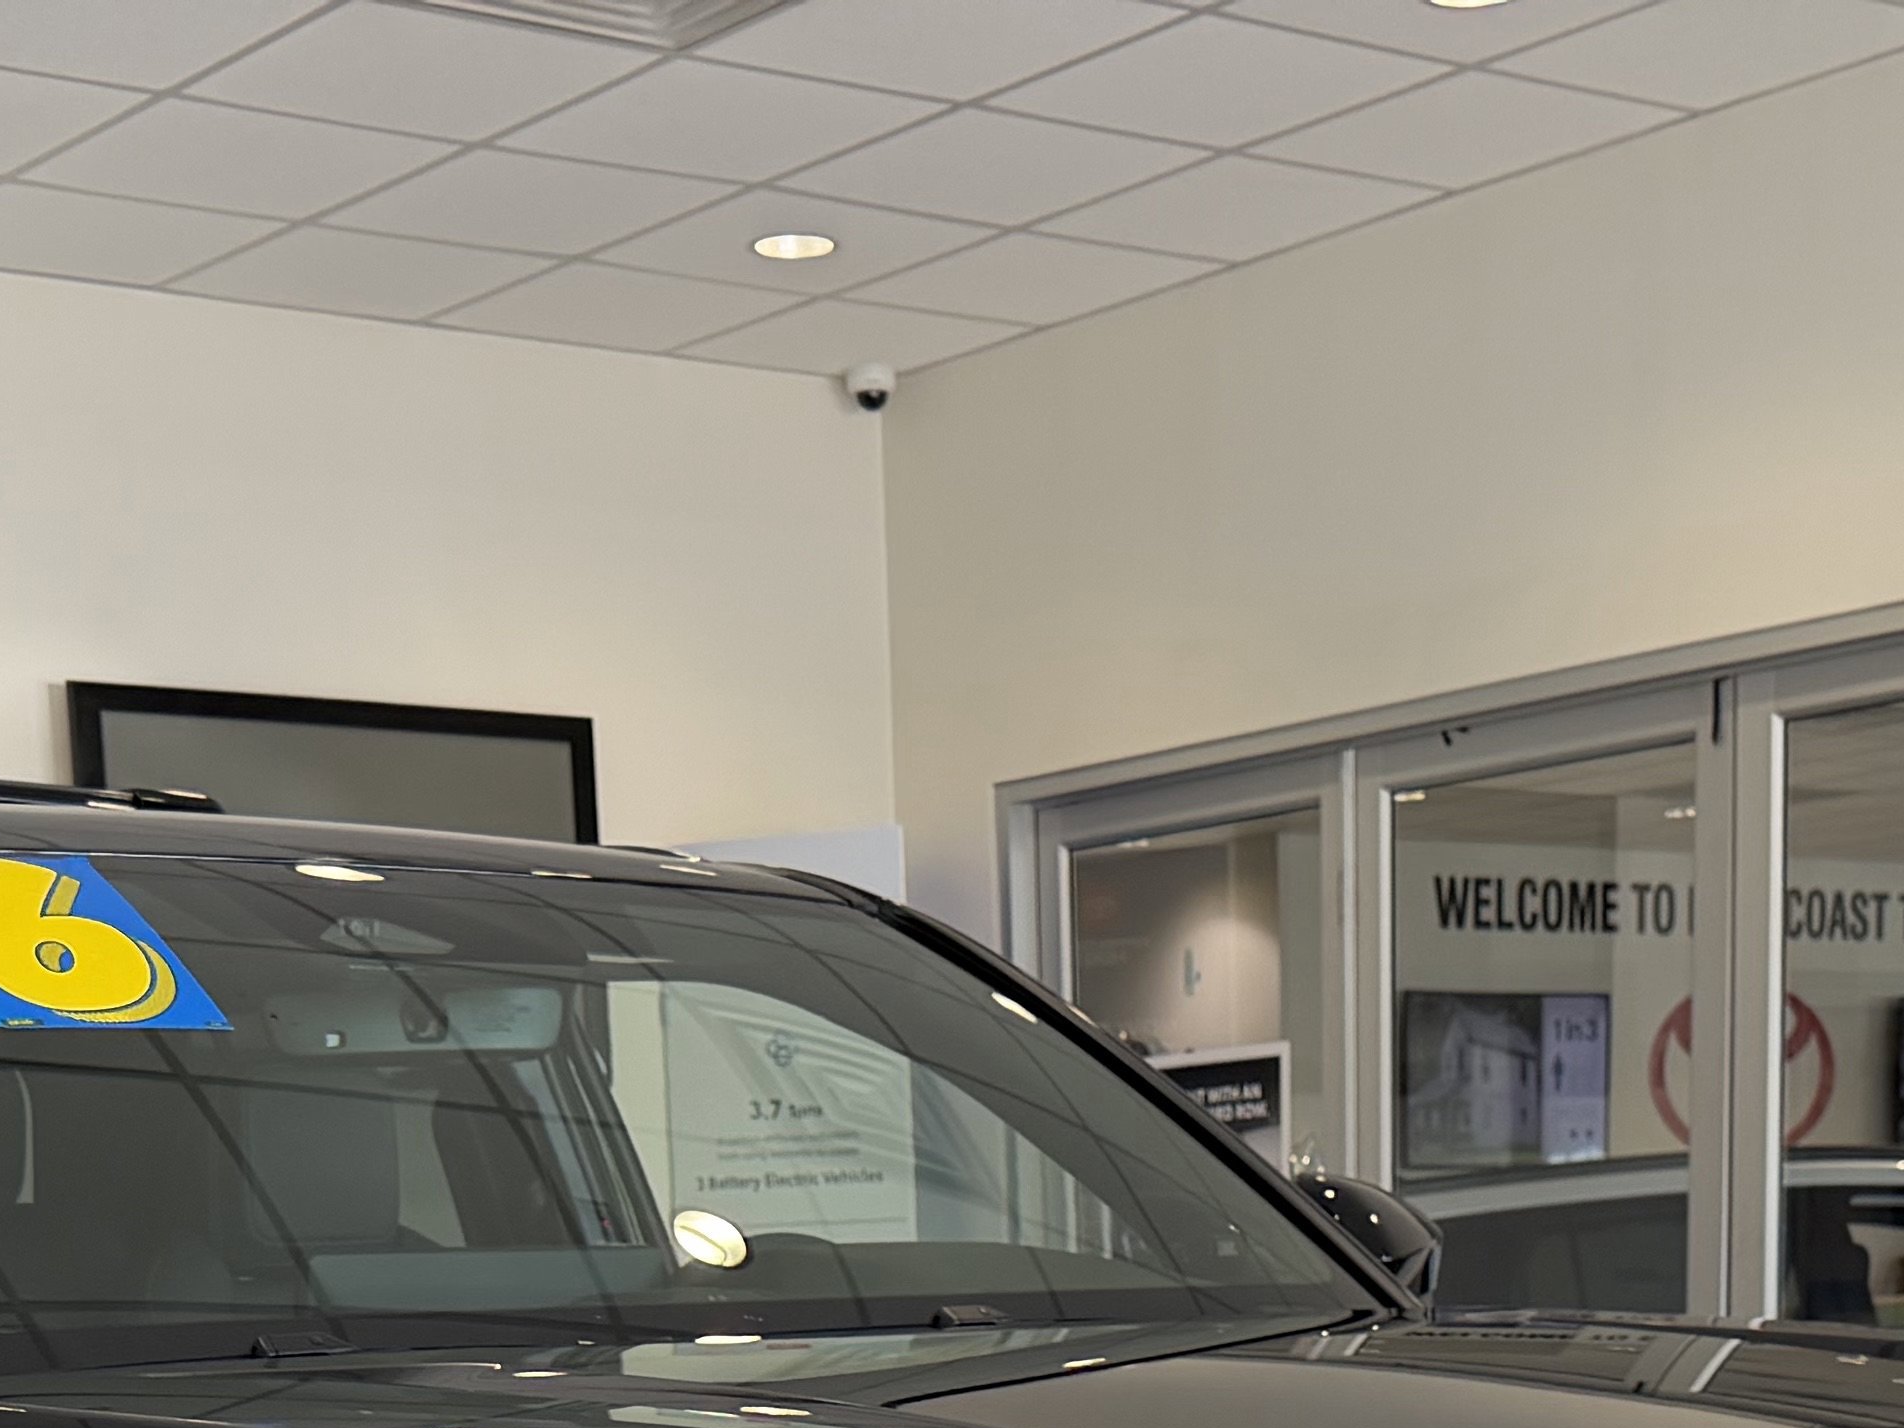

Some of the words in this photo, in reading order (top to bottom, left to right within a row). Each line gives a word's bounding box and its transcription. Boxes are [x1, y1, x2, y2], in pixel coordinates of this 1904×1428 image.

[1433, 874, 1618, 934] WELCOME
[1631, 882, 1674, 937] TO
[1784, 886, 1890, 942] COAST
